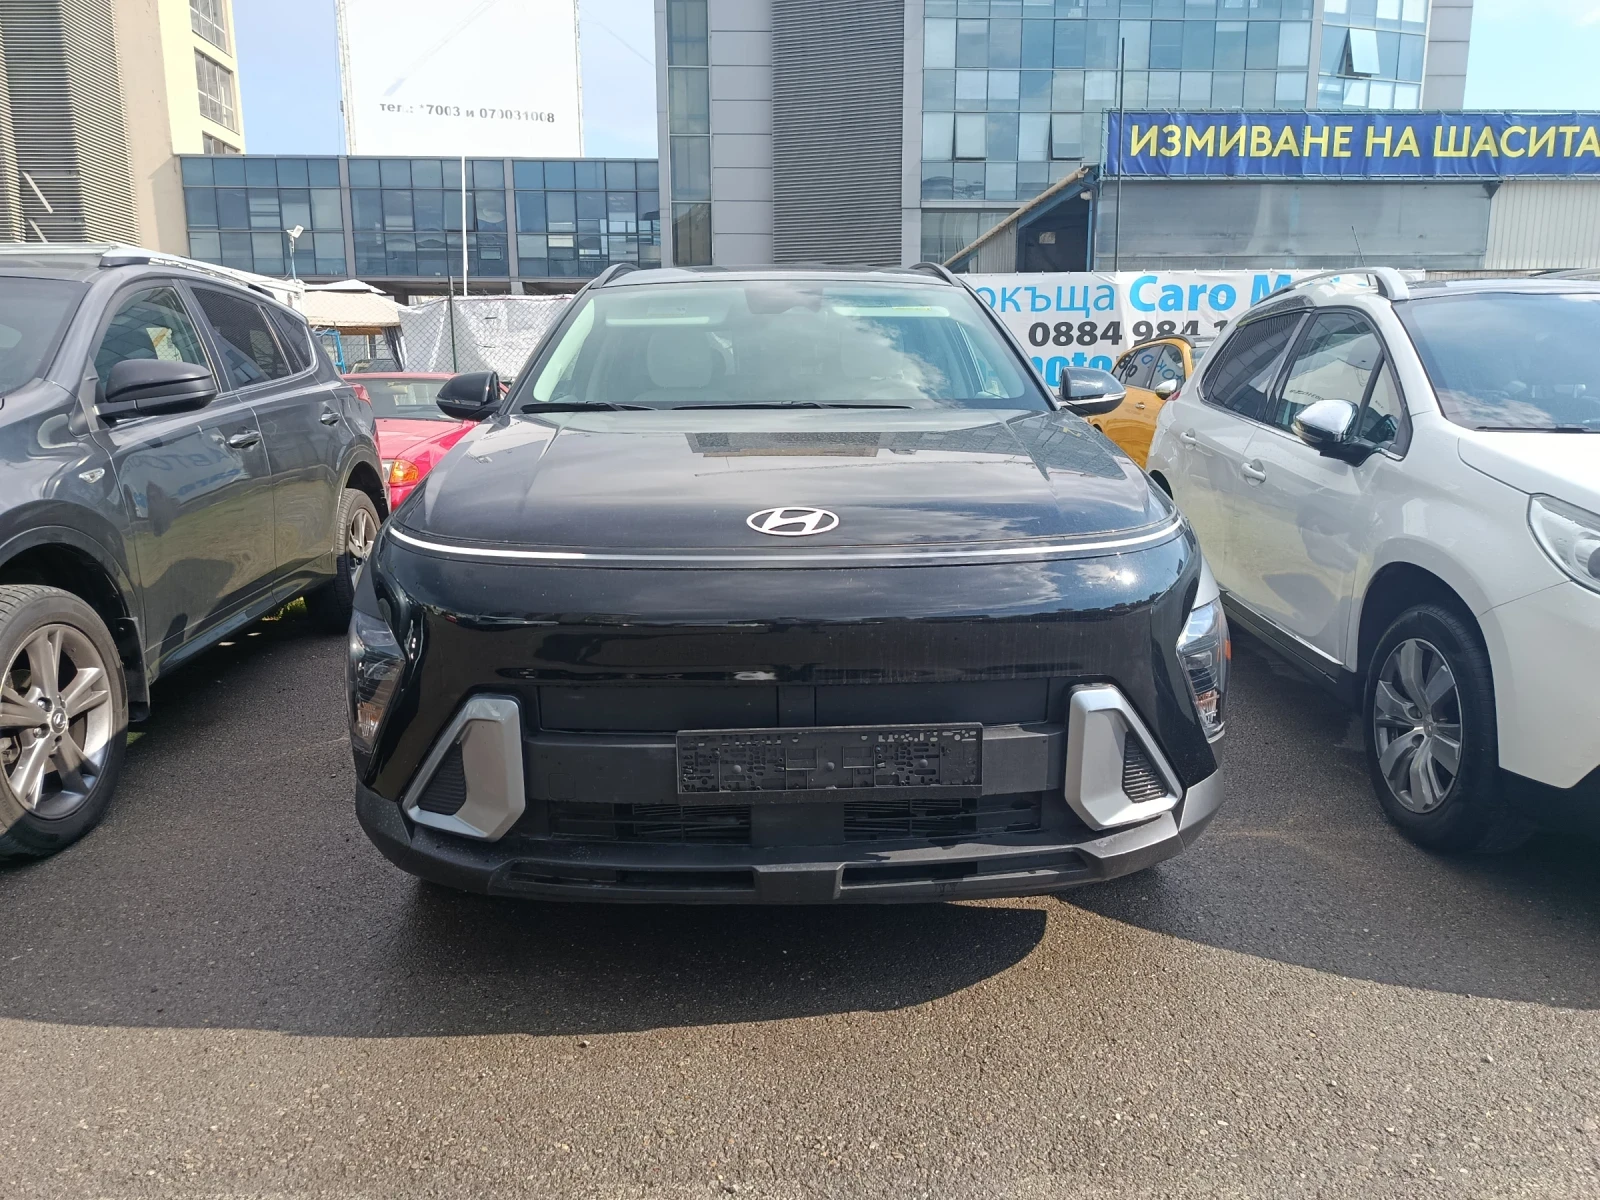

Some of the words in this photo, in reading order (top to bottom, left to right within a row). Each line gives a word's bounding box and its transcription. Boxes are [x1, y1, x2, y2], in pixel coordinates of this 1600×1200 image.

[479, 108, 555, 123] 070031008
[1130, 124, 1352, 158] ИЗМИВАНЕ
[1365, 125, 1420, 158] НА
[1433, 125, 1600, 158] ШАСИТА
[1129, 274, 1237, 313] Caro
[1028, 320, 1123, 347] 0884
